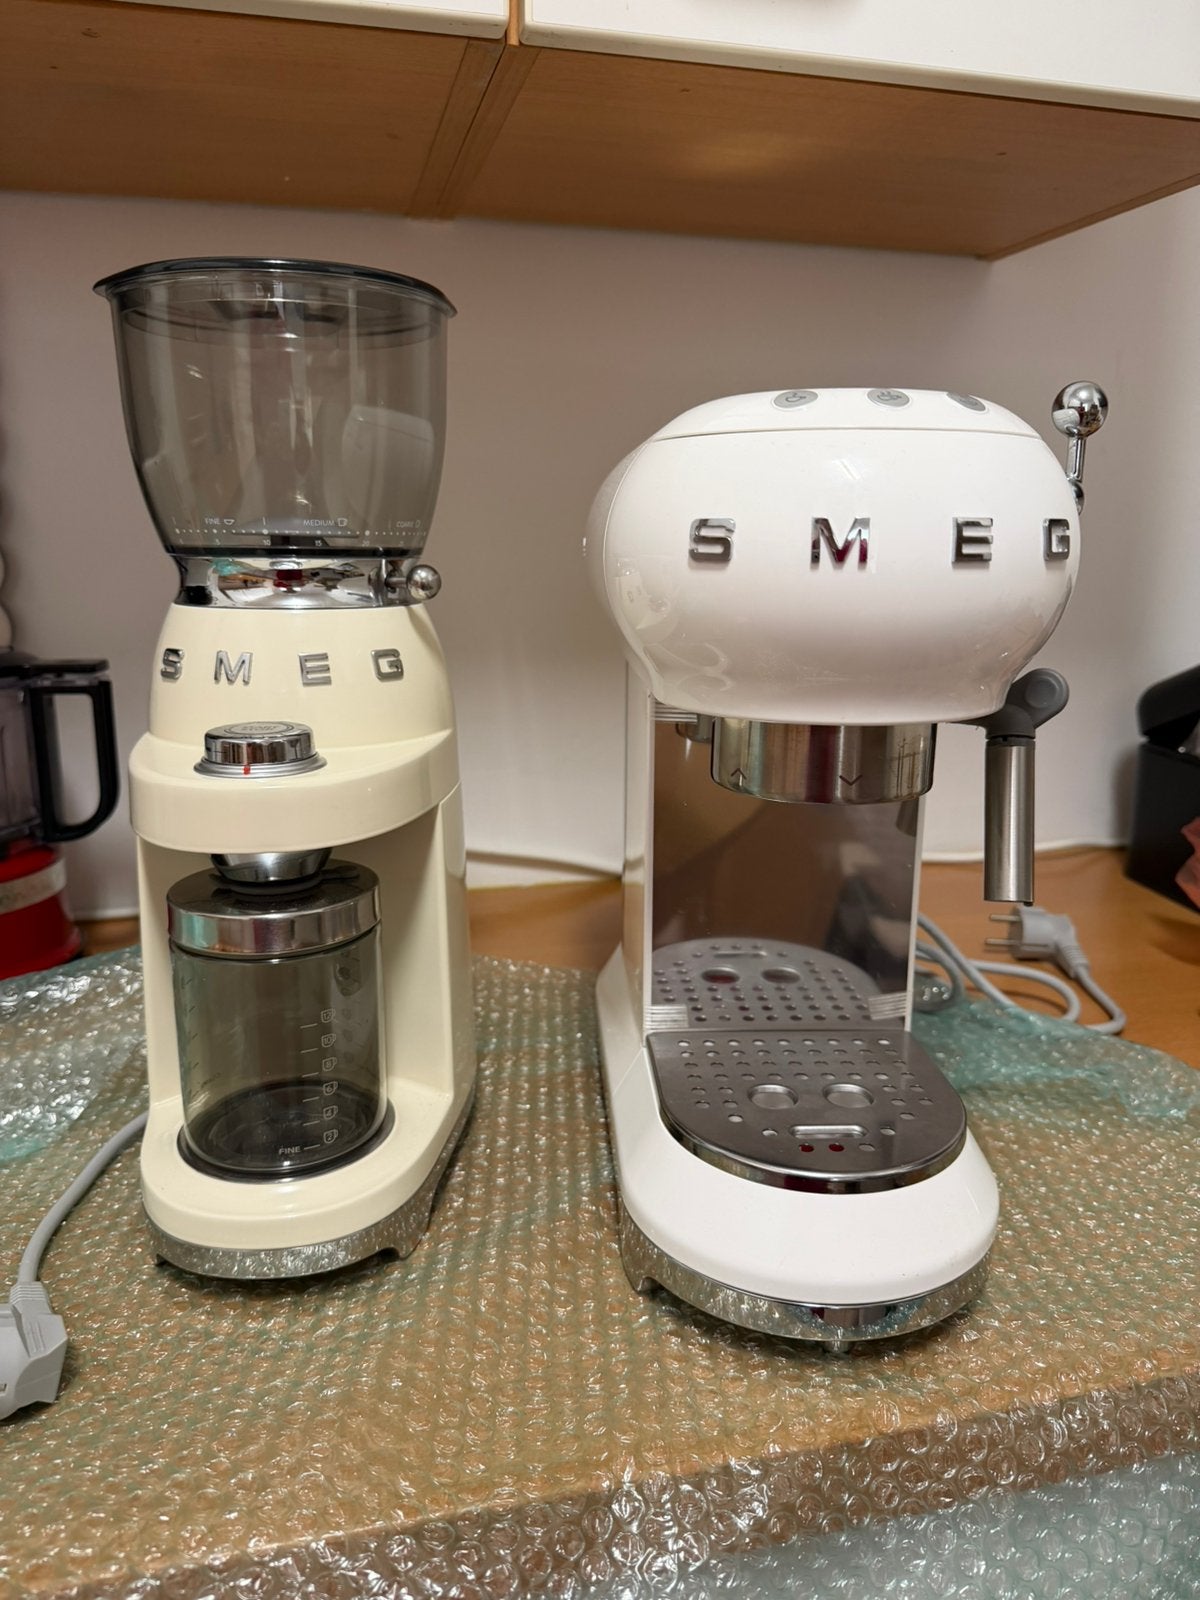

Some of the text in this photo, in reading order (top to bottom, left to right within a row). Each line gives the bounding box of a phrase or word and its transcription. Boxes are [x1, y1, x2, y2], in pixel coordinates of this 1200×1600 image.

[204, 517, 220, 525] FINE
[688, 517, 1070, 564] SMEG
[161, 648, 404, 686] SMEG
[278, 1146, 301, 1155] FINE
